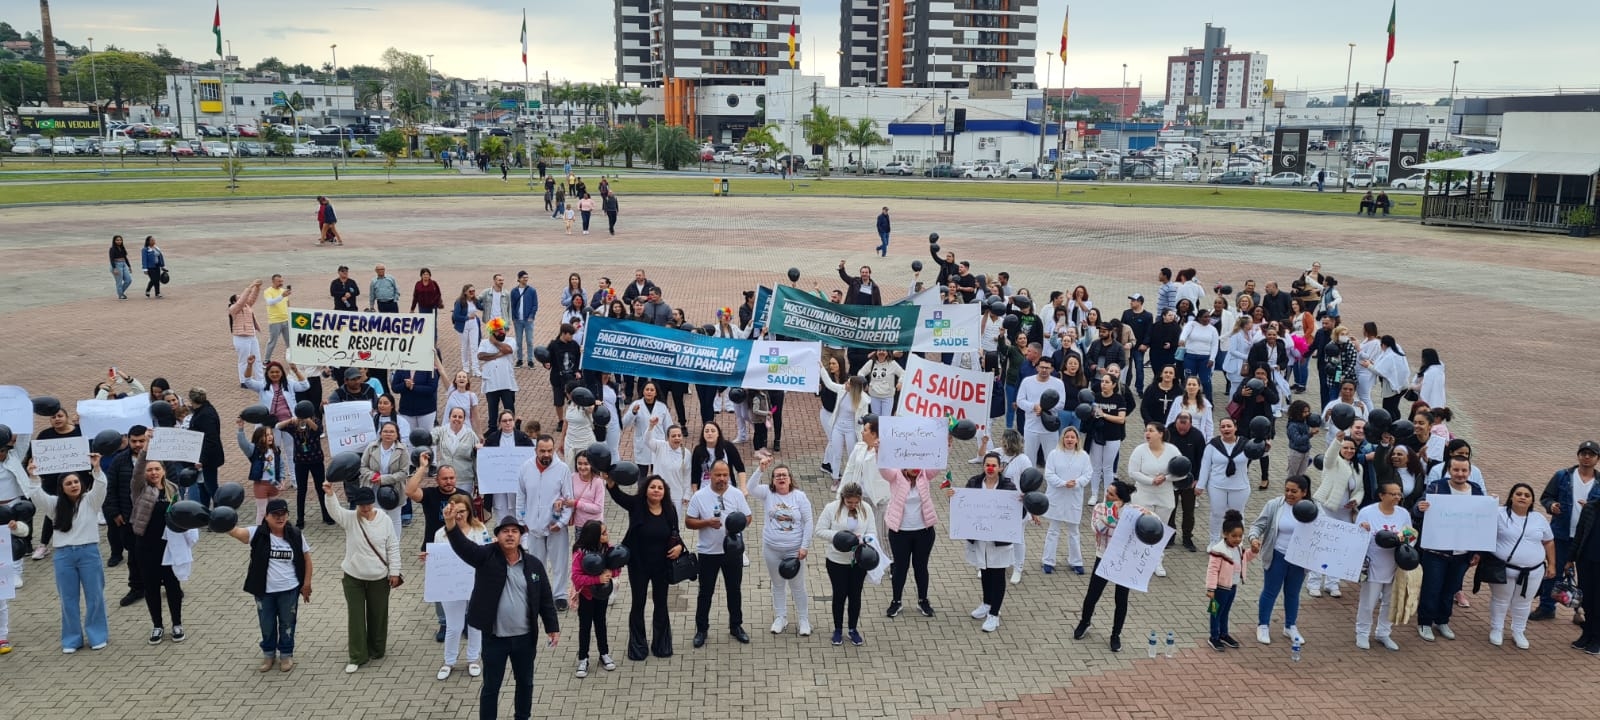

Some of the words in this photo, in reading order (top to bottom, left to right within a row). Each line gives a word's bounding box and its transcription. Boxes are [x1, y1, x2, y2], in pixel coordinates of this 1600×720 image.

[312, 312, 425, 334] ENFERMAGEM
[783, 302, 806, 315] NOSSA
[807, 307, 823, 320] LUTA
[823, 310, 840, 323] NÃO
[840, 315, 858, 328] SERÁ
[858, 317, 875, 329] EM
[878, 315, 901, 330] VÃO.
[784, 314, 826, 332] DEVOLVAM
[828, 326, 854, 339] NOSSO
[855, 329, 899, 342] DIREITO!
[297, 333, 339, 348] MERECE
[348, 335, 415, 356] RESPEITO!
[596, 332, 630, 346] PAGUEM
[630, 337, 637, 346] O
[637, 338, 663, 350] NOSSO
[663, 341, 681, 353] PISO
[682, 345, 718, 358] SALARIAL
[719, 347, 739, 361] JÁ!
[934, 337, 968, 347] SAÚDE
[592, 347, 602, 355] SE
[602, 347, 619, 358] NÃO,
[619, 351, 625, 359] A
[626, 352, 674, 365] ENFERMAGEM
[675, 354, 693, 367] VAI
[694, 357, 735, 373] PARAR!
[767, 374, 806, 385] SAÚDE
[912, 368, 923, 389] A
[926, 374, 986, 404] SAÚDE
[340, 433, 365, 447] LUTO
